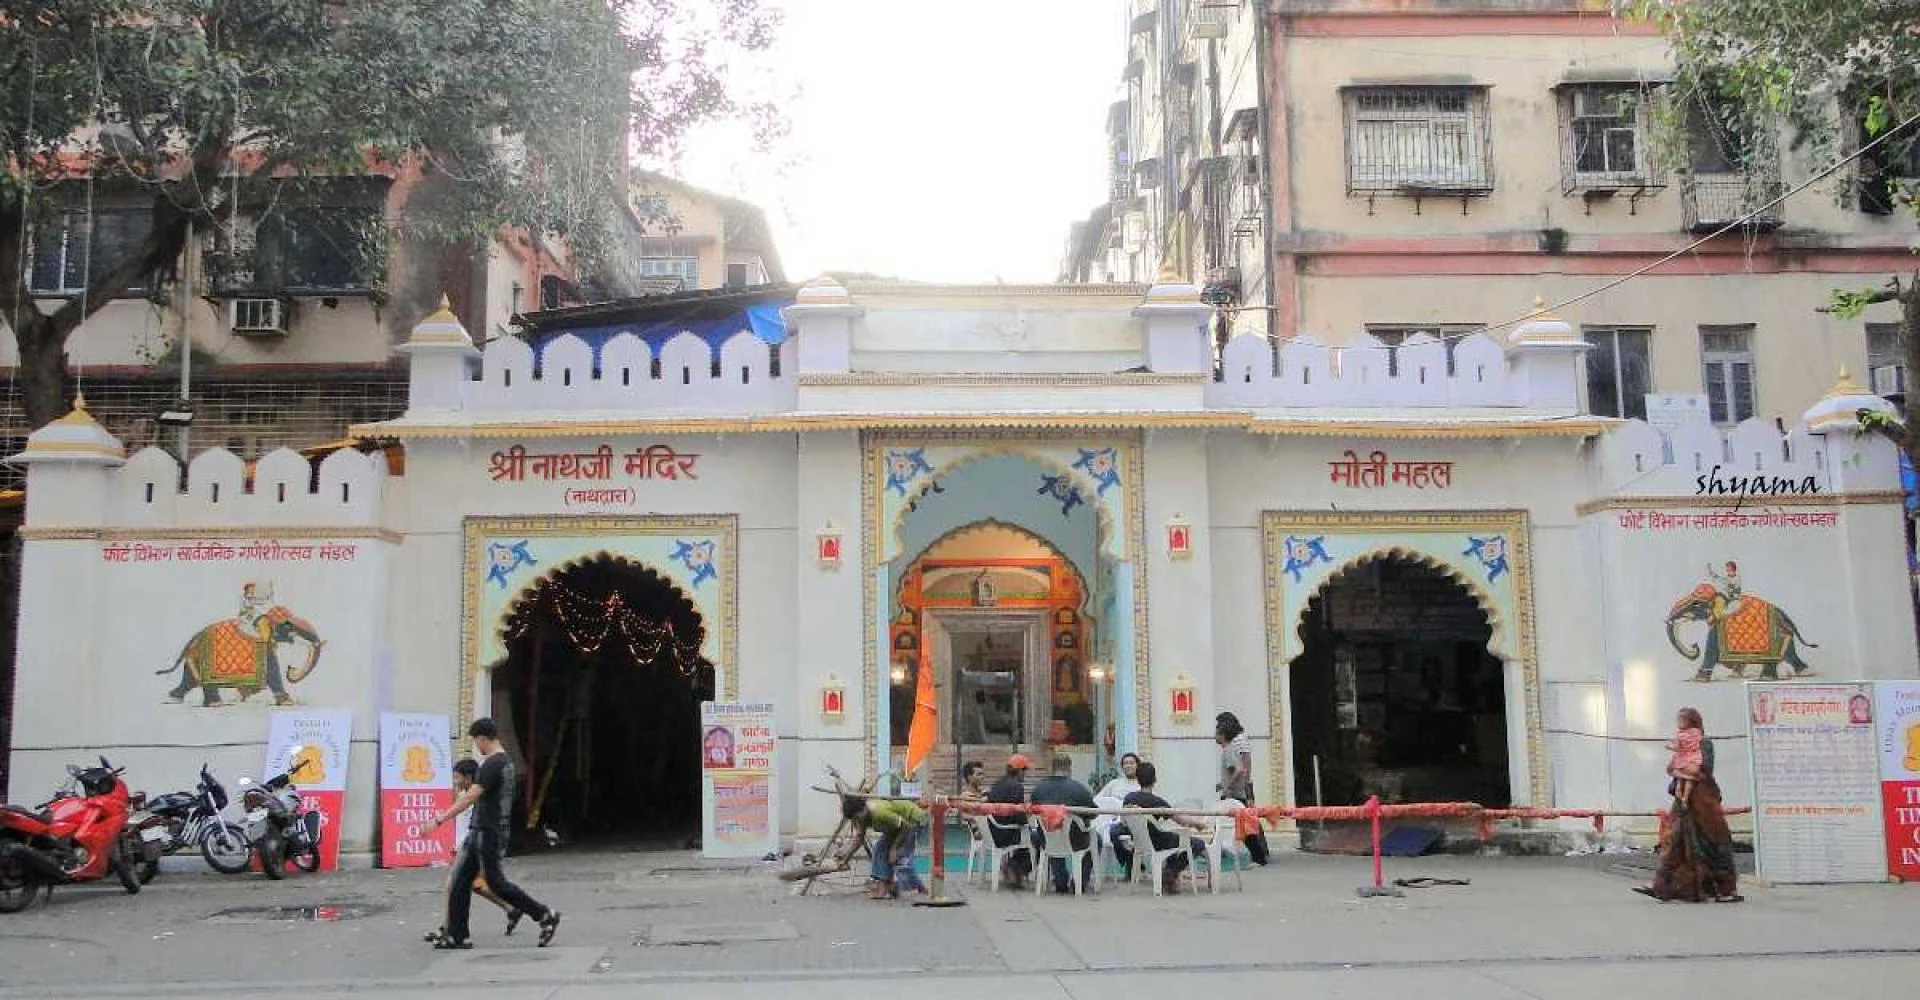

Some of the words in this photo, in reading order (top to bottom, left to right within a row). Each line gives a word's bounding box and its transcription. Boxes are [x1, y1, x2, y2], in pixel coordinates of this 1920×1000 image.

[623, 444, 703, 481] मंदिर
[1327, 450, 1389, 488] मोती
[1391, 461, 1456, 489] महल
[400, 793, 435, 807] THE
[392, 808, 440, 823] TIME
[395, 839, 443, 855] INDIA
